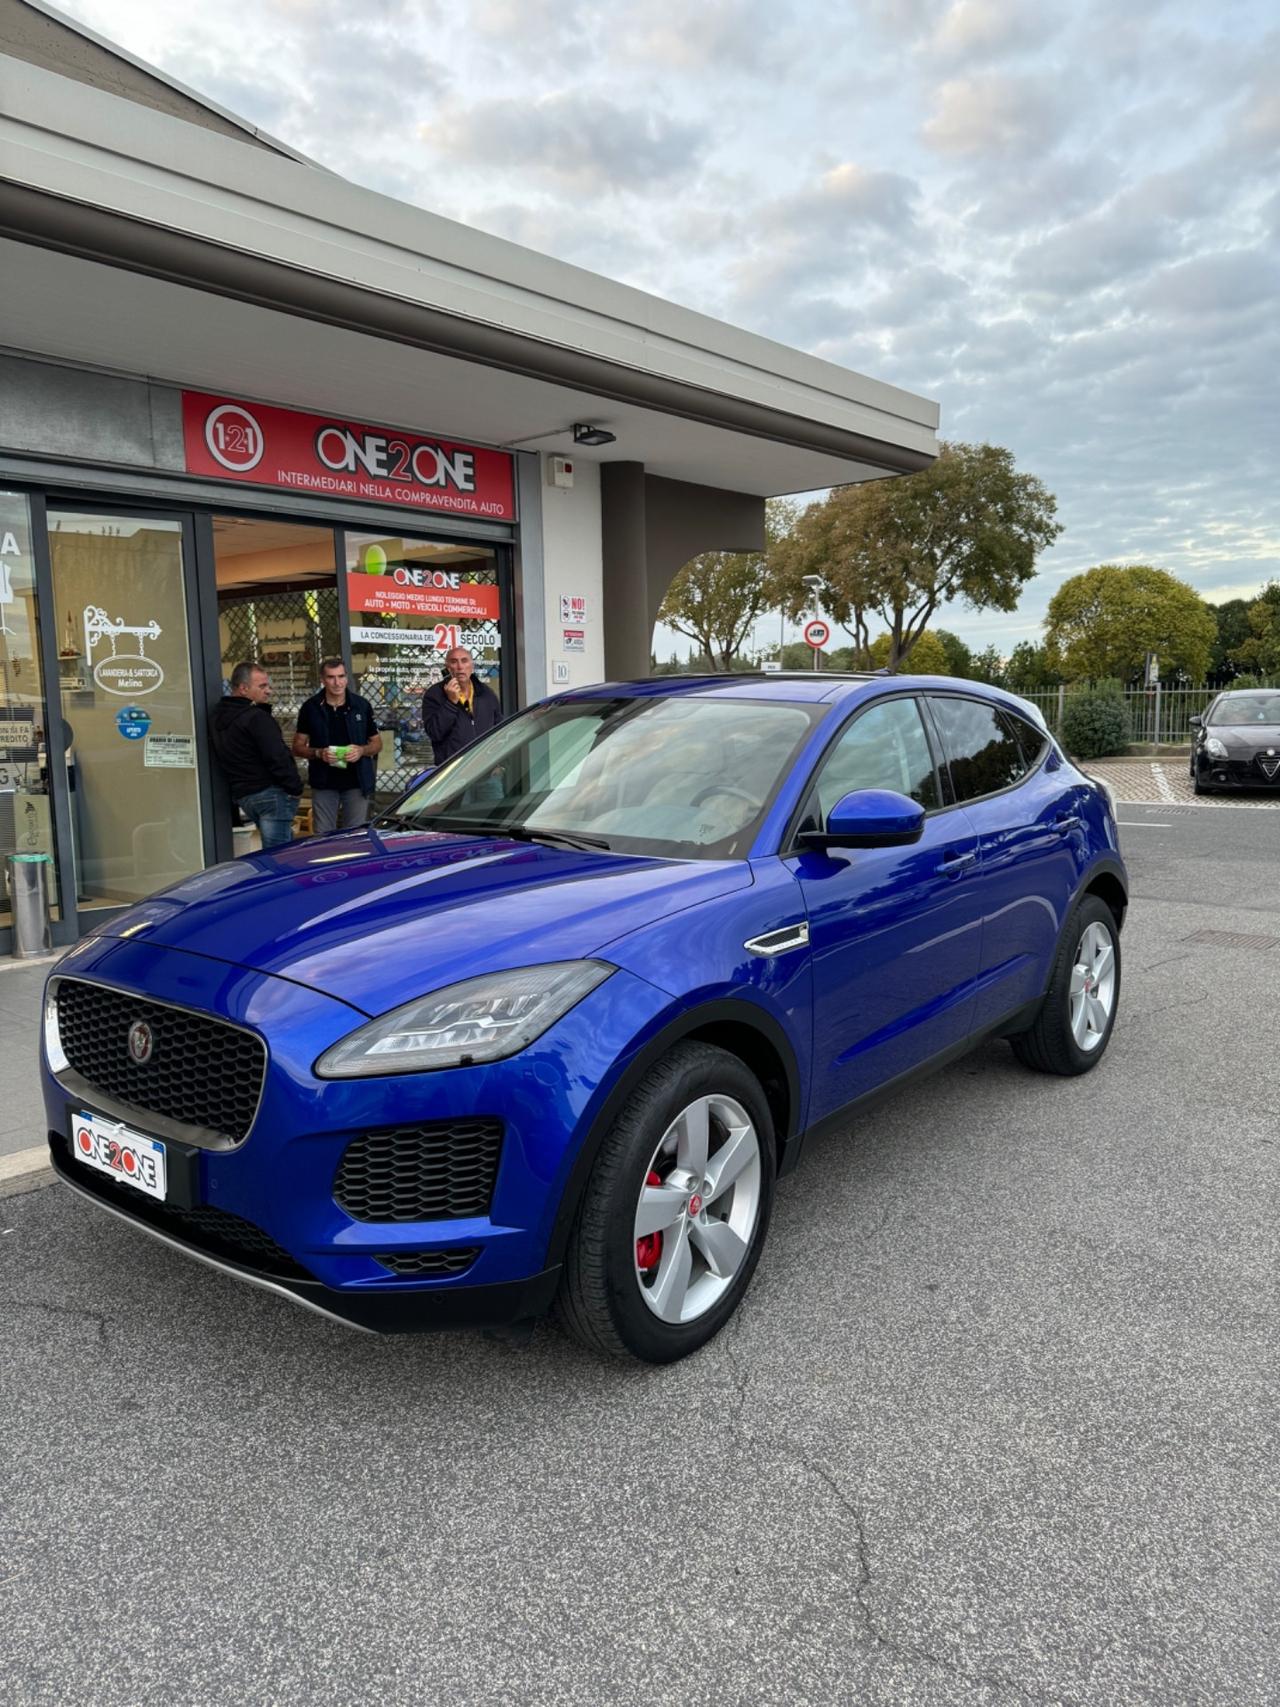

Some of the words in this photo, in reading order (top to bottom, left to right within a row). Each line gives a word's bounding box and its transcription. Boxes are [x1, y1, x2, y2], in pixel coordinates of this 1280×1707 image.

[316, 424, 476, 494] ONE2ONE
[277, 469, 357, 493] INTERMEDIARI
[359, 482, 392, 497] NELLA
[395, 488, 477, 511] COMPRAVENDITA
[480, 501, 504, 515] AUTO
[393, 567, 461, 590] ONE2ONE
[364, 598, 384, 608] AUTO
[390, 600, 411, 610] MOTO
[416, 602, 442, 612] VEICOLI
[443, 604, 487, 615] COMMERCIALI
[375, 591, 405, 600] NOLEGGIO
[406, 593, 424, 602] MEDIO
[425, 594, 444, 603] LUNGO
[445, 596, 468, 605] TERMINE
[571, 598, 585, 610] NO!
[361, 631, 370, 639] LA
[370, 632, 423, 642] CONCESSIONARIA
[424, 633, 435, 642] DEL
[460, 634, 495, 646] SECOLO
[77, 1127, 156, 1188] ONE2ONE
